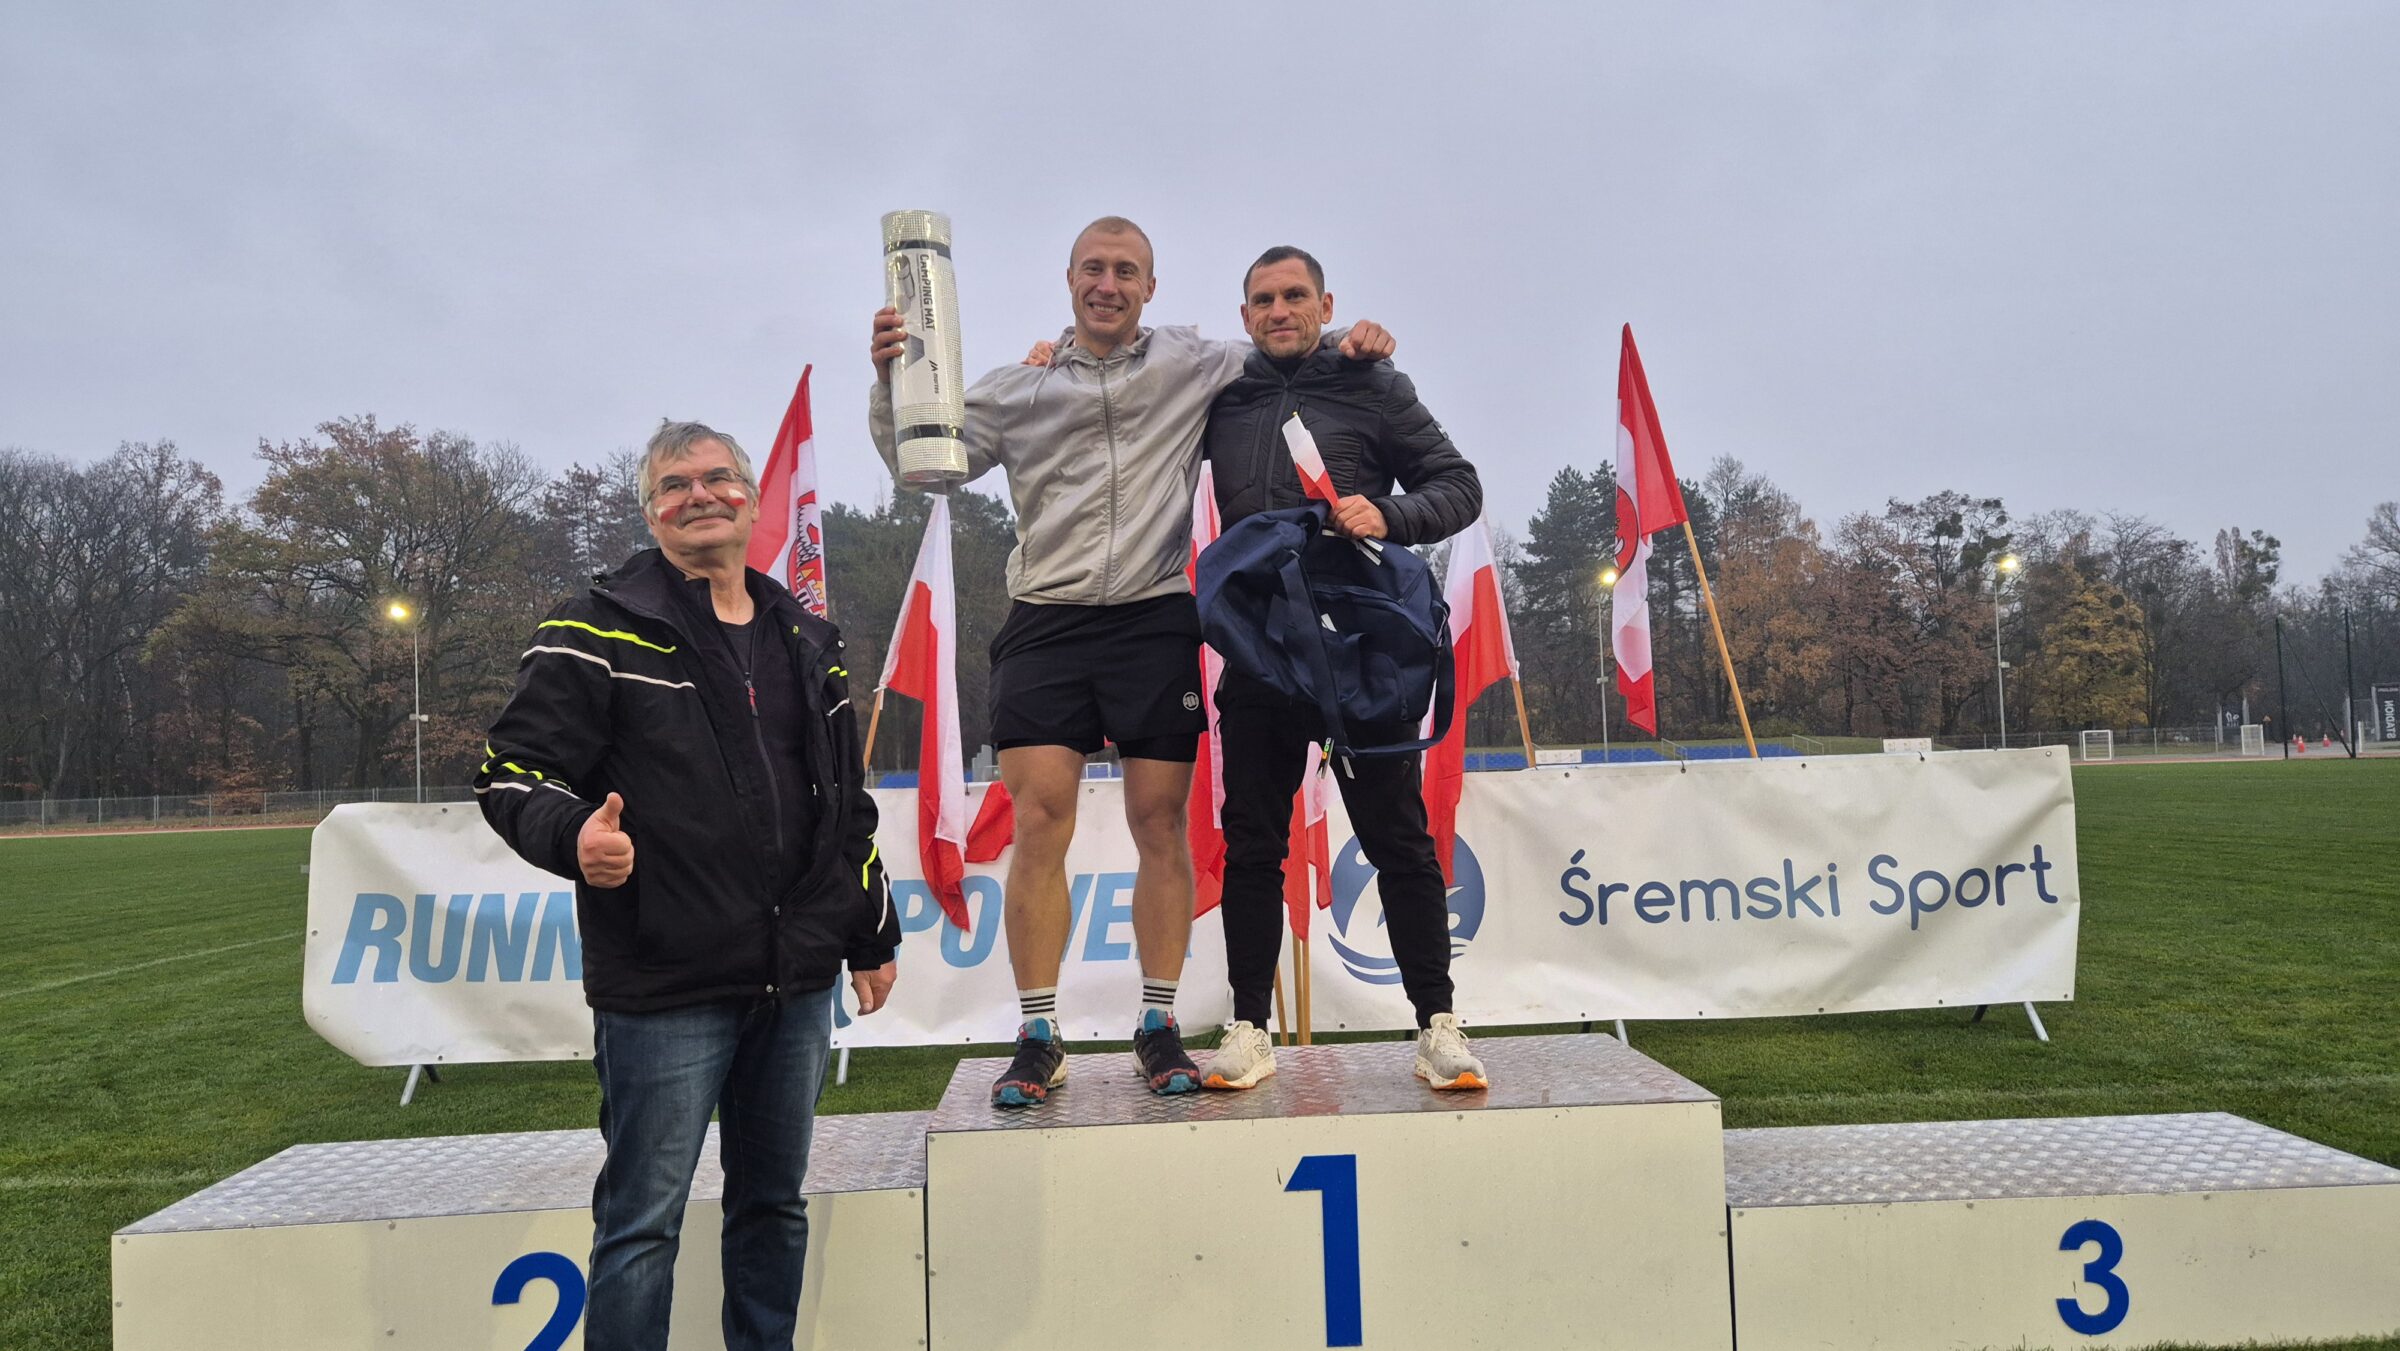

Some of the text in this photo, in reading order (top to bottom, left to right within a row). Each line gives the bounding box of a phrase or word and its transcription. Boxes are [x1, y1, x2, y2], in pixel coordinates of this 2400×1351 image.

[919, 253, 933, 305] CAMPING
[922, 307, 935, 330] MAT
[889, 872, 1191, 969] POE
[1559, 844, 2058, 931] Śremski Sport
[1284, 1154, 1363, 1347] 1
[2056, 1219, 2130, 1335] 3
[491, 1251, 587, 1351] 2
